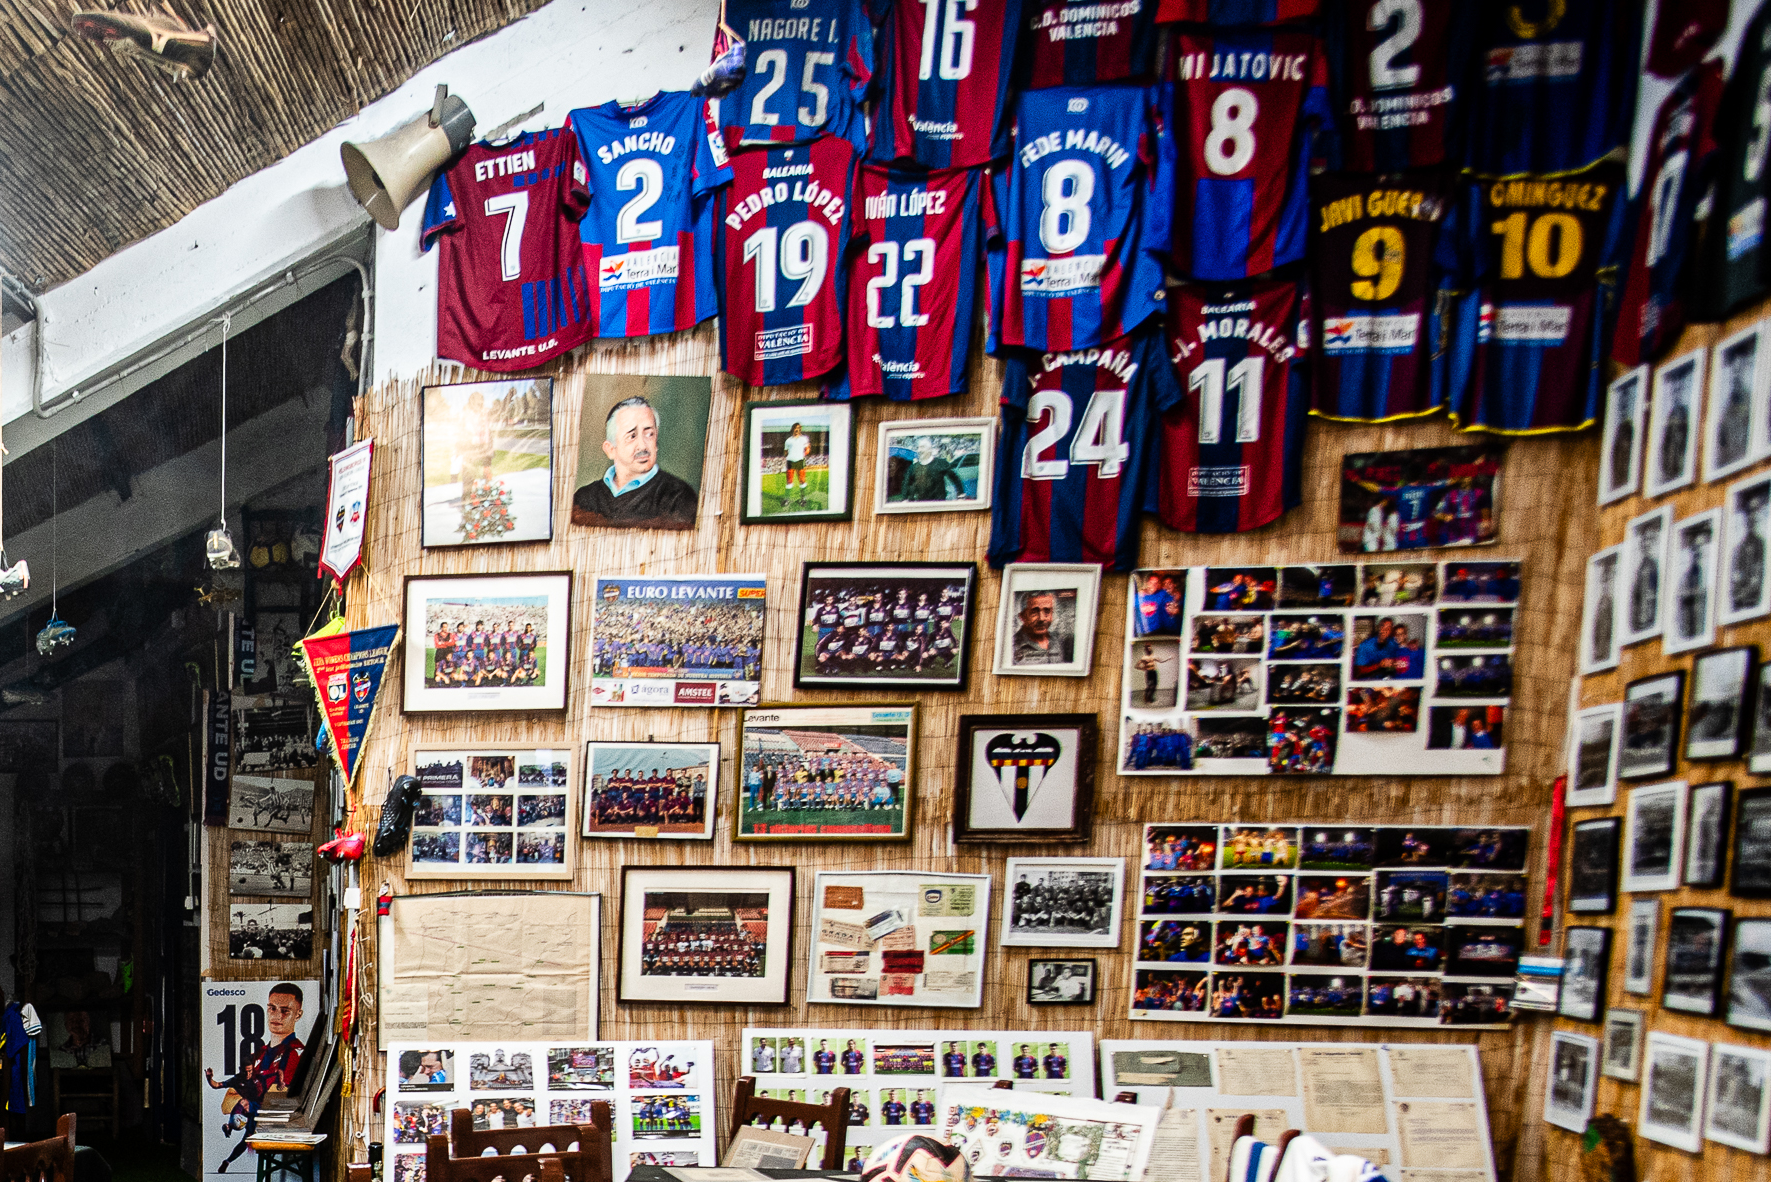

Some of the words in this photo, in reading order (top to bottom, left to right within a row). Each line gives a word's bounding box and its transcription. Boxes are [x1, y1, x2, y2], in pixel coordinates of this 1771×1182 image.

[748, 18, 821, 42] NAGORE
[918, 0, 976, 80] 16
[1049, 21, 1119, 42] VALENCIA
[1366, 0, 1424, 90] 2
[750, 49, 835, 127] 25
[597, 131, 676, 164] SANCHO
[1204, 87, 1258, 176] 8
[475, 150, 535, 182] ETTIEN
[616, 158, 663, 244] 2
[725, 180, 789, 231] PEDRO
[792, 179, 846, 226] LÓPEZ
[865, 190, 897, 219] IVÁN
[899, 187, 947, 217] LÓPEZ
[1039, 159, 1095, 254] 8
[484, 191, 528, 282] 7
[743, 220, 828, 313] 19
[1351, 225, 1406, 301] 9
[1491, 212, 1583, 280] 10
[657, 263, 677, 275] Mar
[866, 238, 935, 328] 22
[482, 344, 536, 361] LEVANTE
[1197, 318, 1295, 363] MORALES
[1188, 355, 1265, 444] 11
[1021, 389, 1129, 480] 24
[627, 586, 668, 599] EURO
[671, 586, 734, 600] LEVANTE
[641, 684, 669, 695] ágora
[678, 688, 713, 698] AMSTEL
[743, 712, 780, 723] Levante
[207, 988, 246, 997] Gedesco
[217, 1003, 265, 1076] 18
